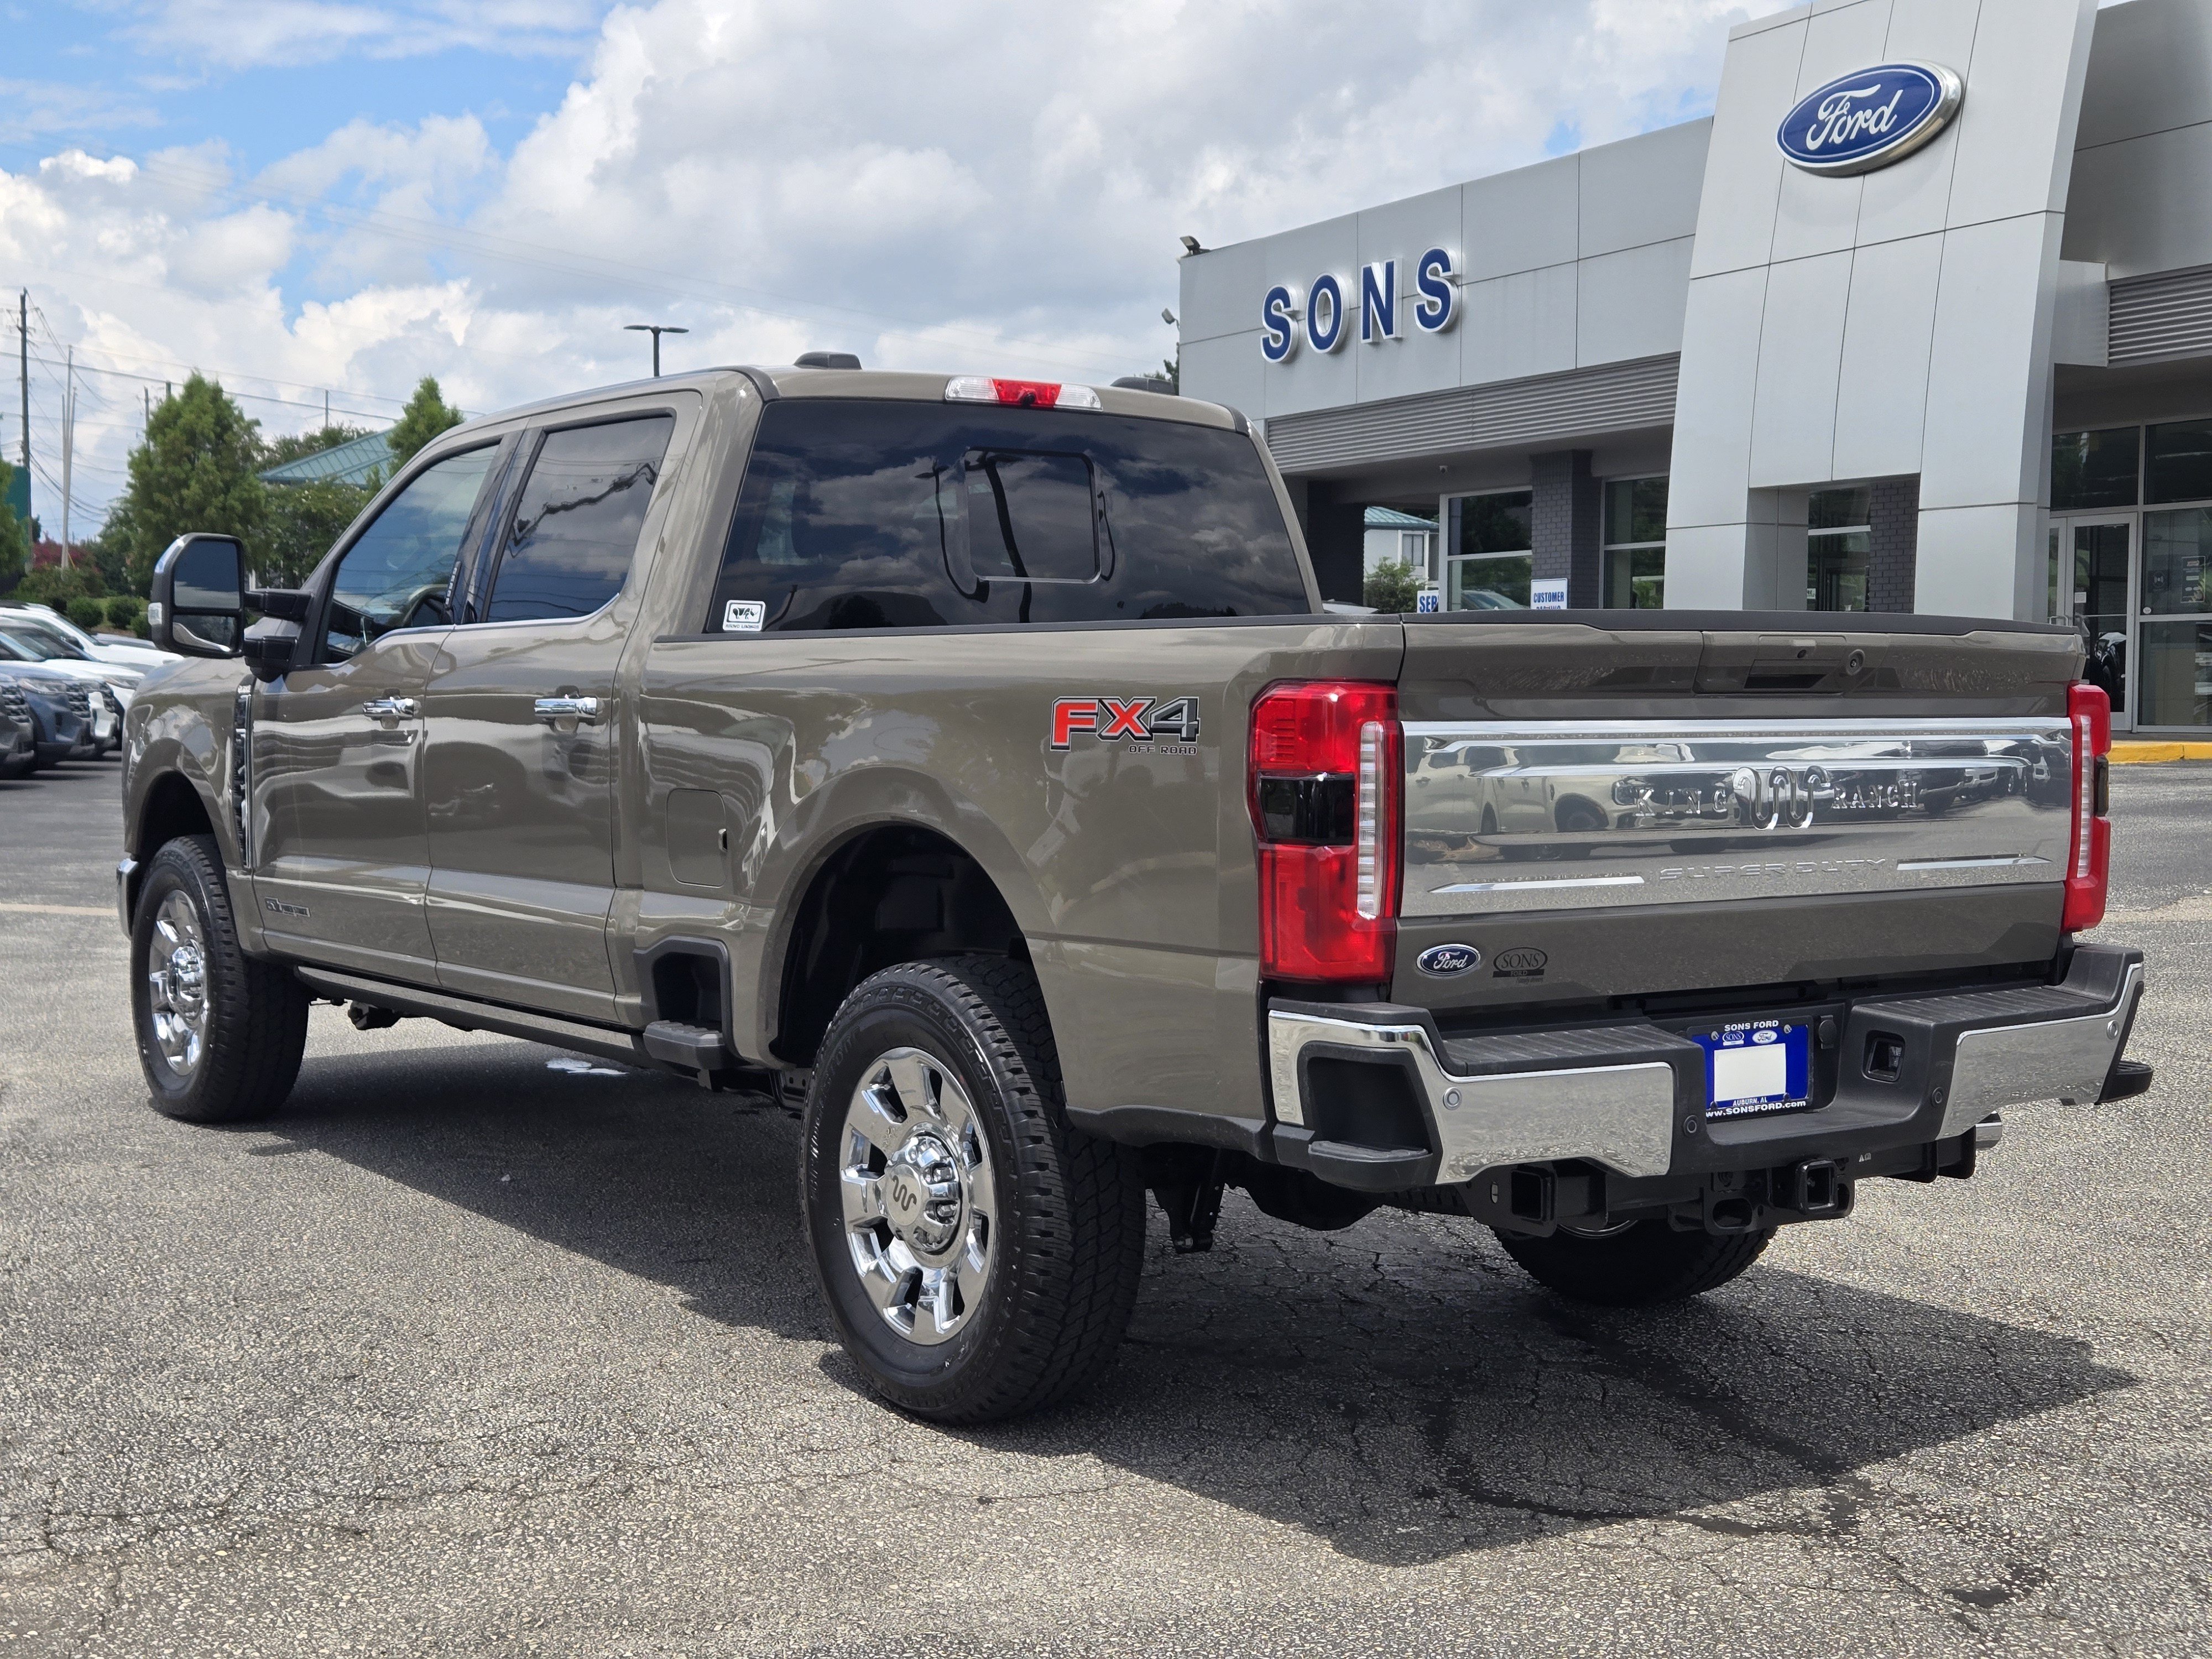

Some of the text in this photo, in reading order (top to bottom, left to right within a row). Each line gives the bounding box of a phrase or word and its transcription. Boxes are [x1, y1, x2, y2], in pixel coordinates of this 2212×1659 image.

[1806, 84, 1903, 150] Ford
[1260, 246, 1461, 364] SONS
[1419, 595, 1439, 613] SER
[1533, 591, 1564, 603] CUSTOMER
[1050, 696, 1201, 752] FX4
[1129, 744, 1198, 756] OFF ROAD
[1632, 780, 1917, 817] KING RANCH
[1433, 951, 1468, 969] Ford
[1501, 953, 1540, 969] SONS
[1724, 1020, 1779, 1032] SONS FORD
[1725, 1032, 1741, 1041] SONS
[1705, 1100, 1807, 1118] ww.SONSFORD.com
